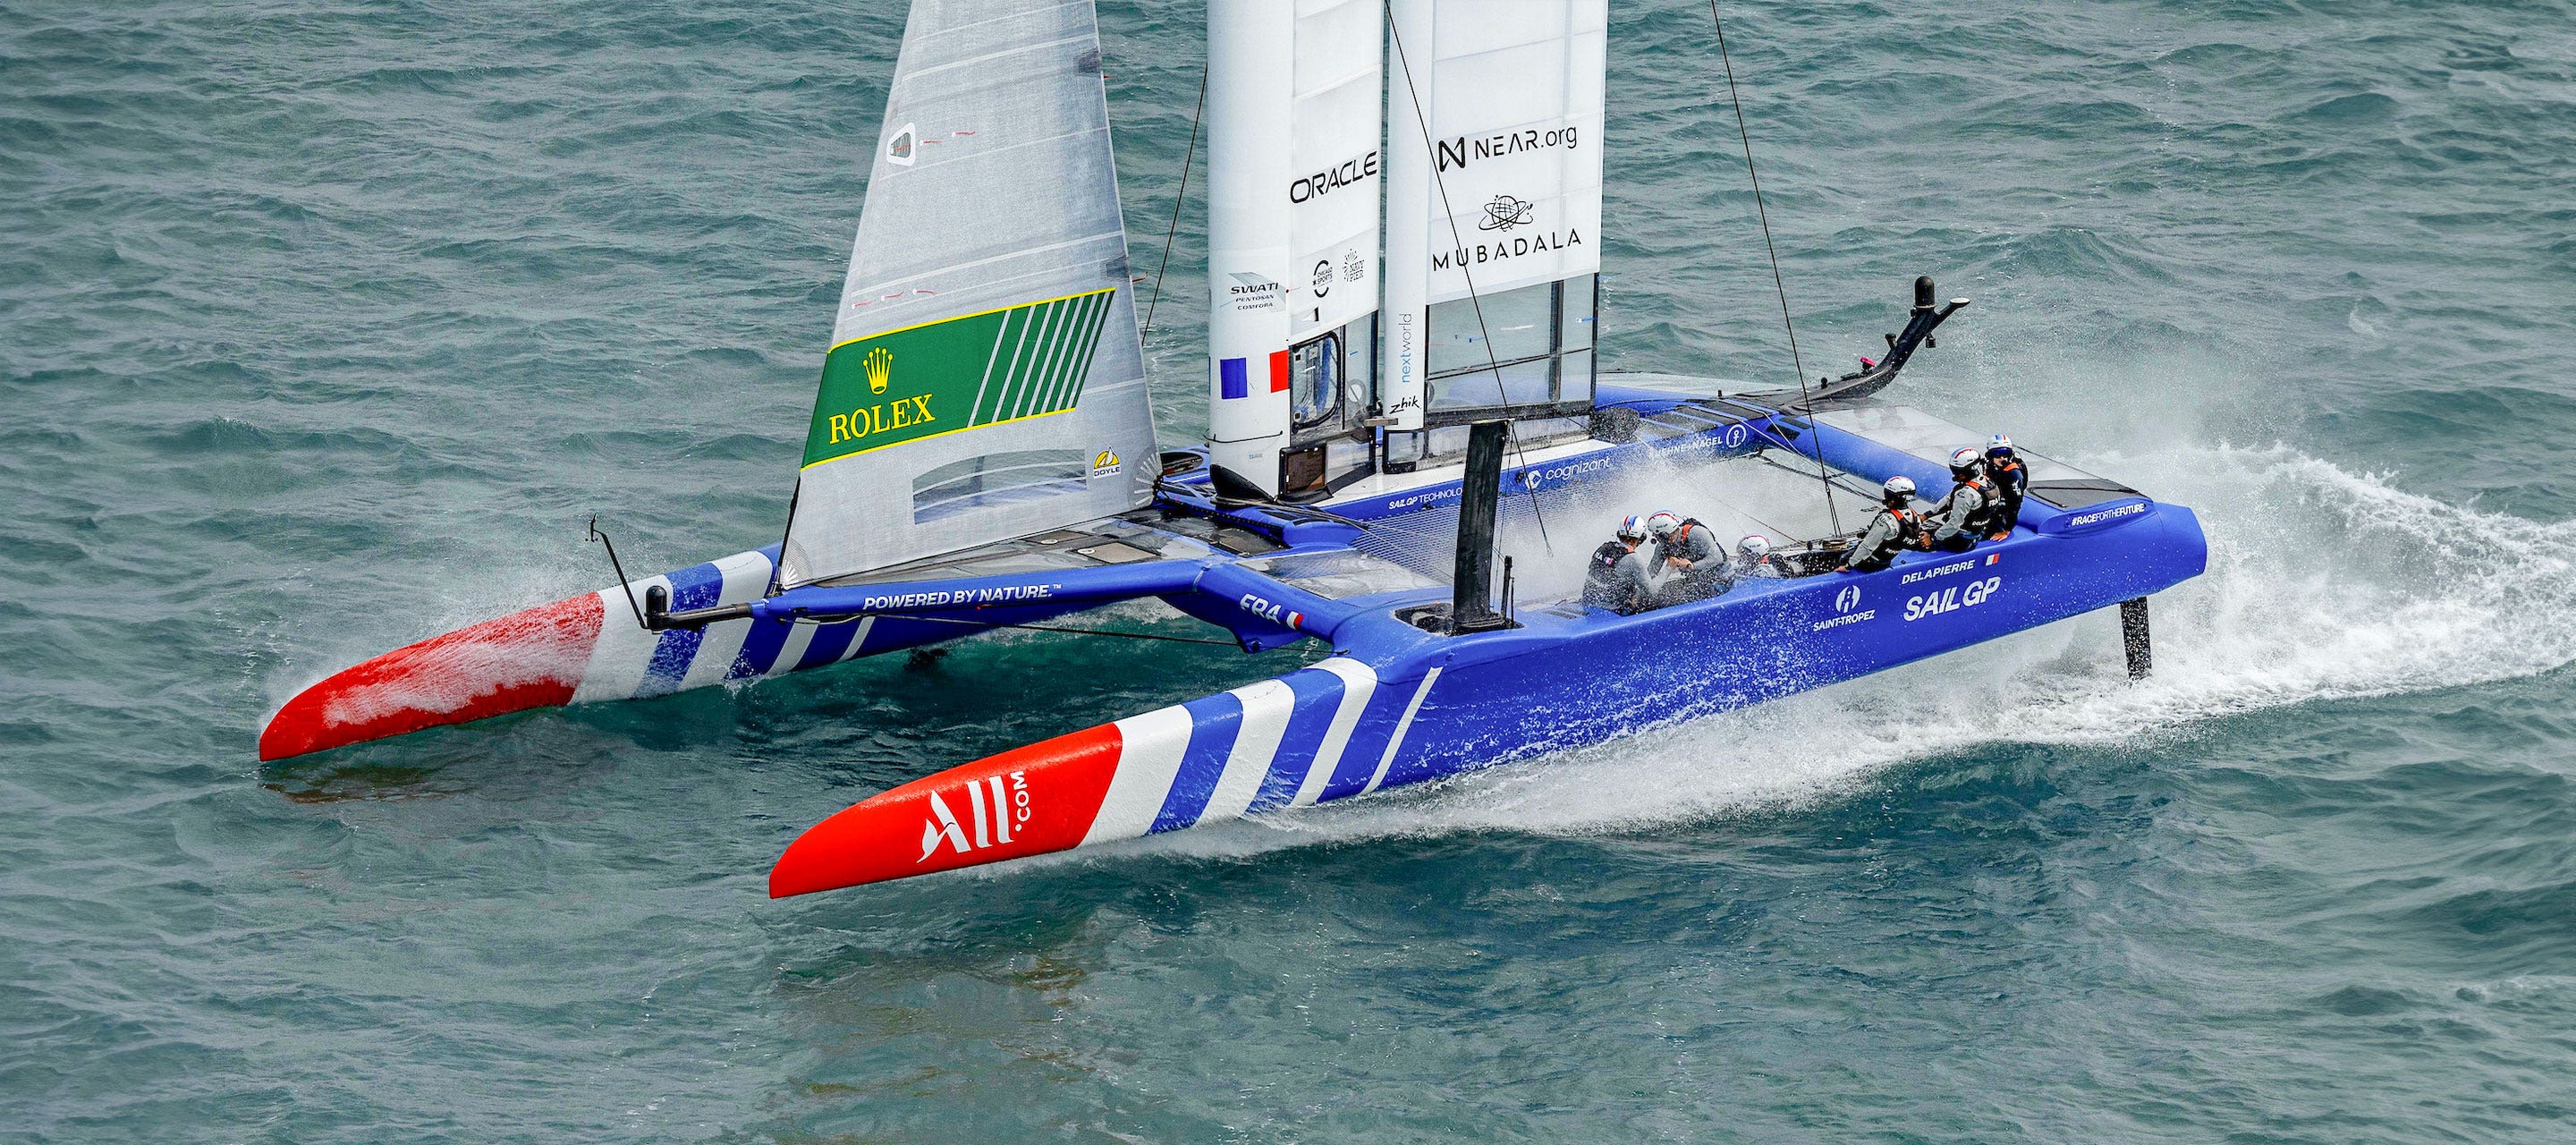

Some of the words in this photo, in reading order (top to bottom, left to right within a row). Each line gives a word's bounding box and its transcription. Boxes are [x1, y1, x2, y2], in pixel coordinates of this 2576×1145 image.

[1475, 126, 1577, 160] NEAR.org
[1290, 150, 1377, 204] ORACLE
[1433, 228, 1581, 271] MUBADALA
[1230, 282, 1279, 294] SWATI
[1398, 313, 1412, 384] nextworld
[1389, 394, 1420, 415] zhik
[828, 394, 936, 445] ROLEX
[1093, 466, 1121, 477] DOYLE
[1545, 455, 1611, 481] cognizant
[1419, 487, 1463, 504] TECHNOLO
[2071, 503, 2145, 526] #RACEFORTHEFUTURE
[1902, 559, 1976, 585] DELAPIERRE
[862, 591, 952, 611] POWERED
[952, 589, 978, 605] BY
[1240, 593, 1282, 624] FRA
[1813, 609, 1876, 632] SAINT-TROPEZ
